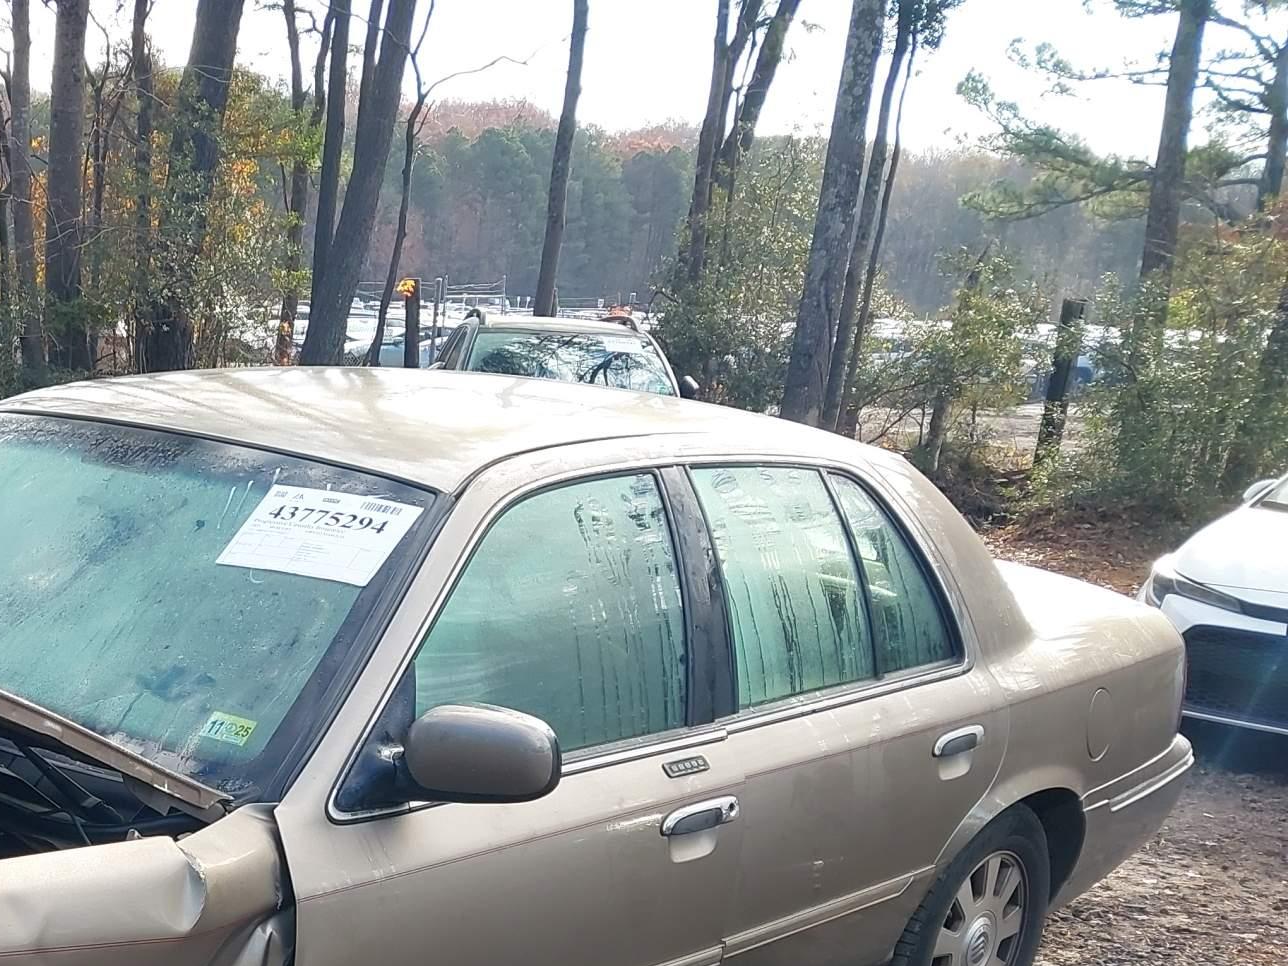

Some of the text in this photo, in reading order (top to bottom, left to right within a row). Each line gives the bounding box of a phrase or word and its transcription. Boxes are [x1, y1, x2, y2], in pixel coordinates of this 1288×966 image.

[268, 504, 390, 534] 43775294
[208, 719, 252, 738] 11 25
